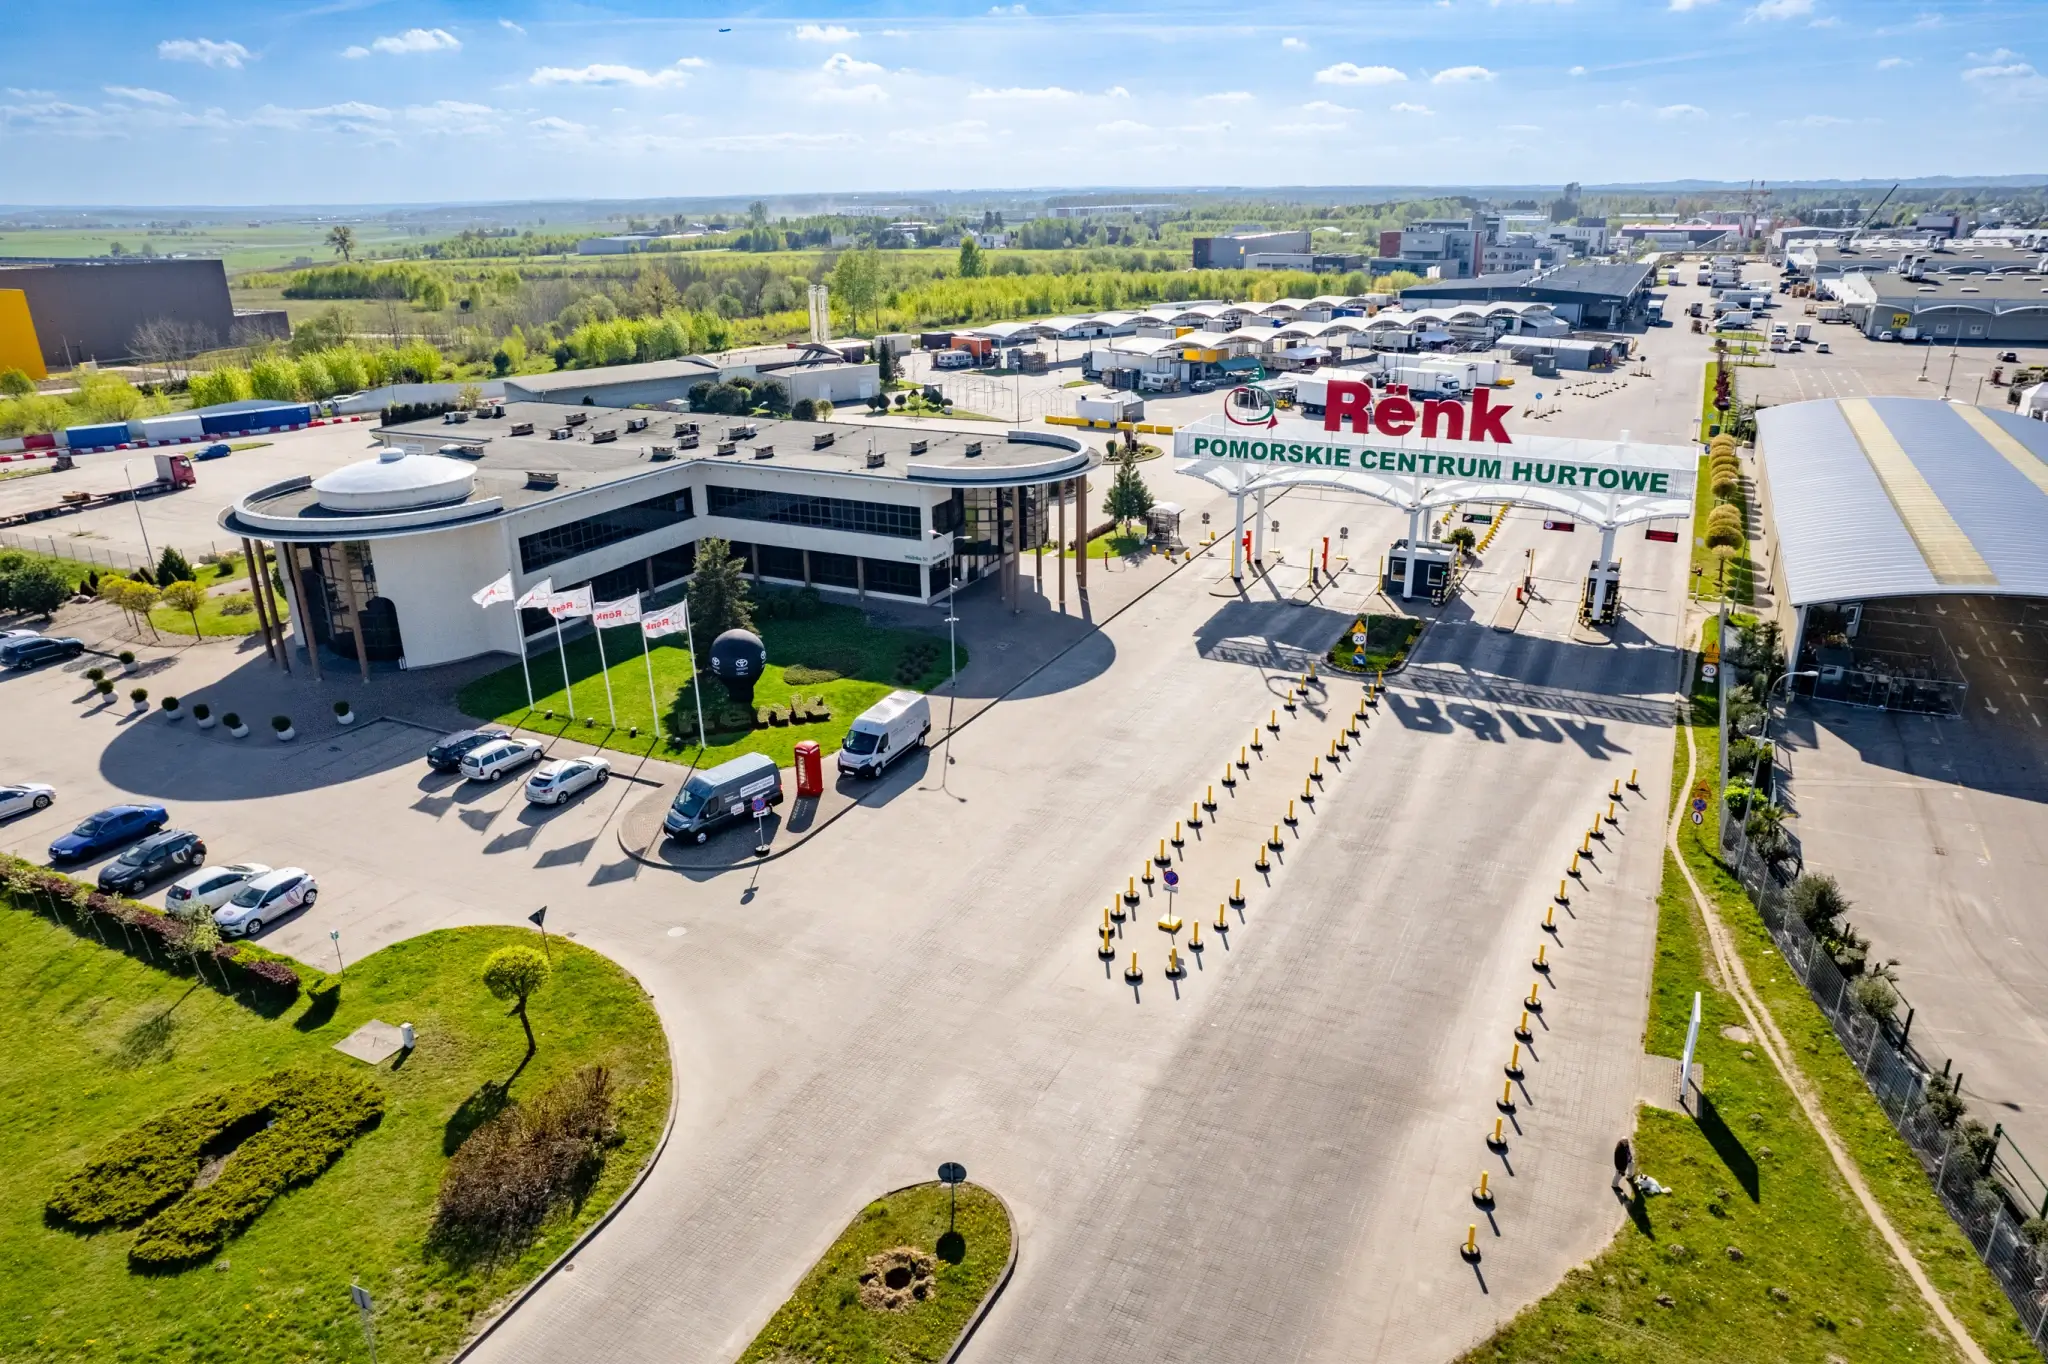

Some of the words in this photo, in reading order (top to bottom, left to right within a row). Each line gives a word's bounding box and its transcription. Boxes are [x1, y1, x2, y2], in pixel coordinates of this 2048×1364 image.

[1892, 316, 1908, 326] H2
[1324, 379, 1514, 444] Rënk
[1194, 437, 1350, 467] POMORSKIE
[1360, 450, 1501, 480] CENTRUM
[1512, 461, 1669, 493] HURTOWE
[1704, 666, 1714, 674] 20
